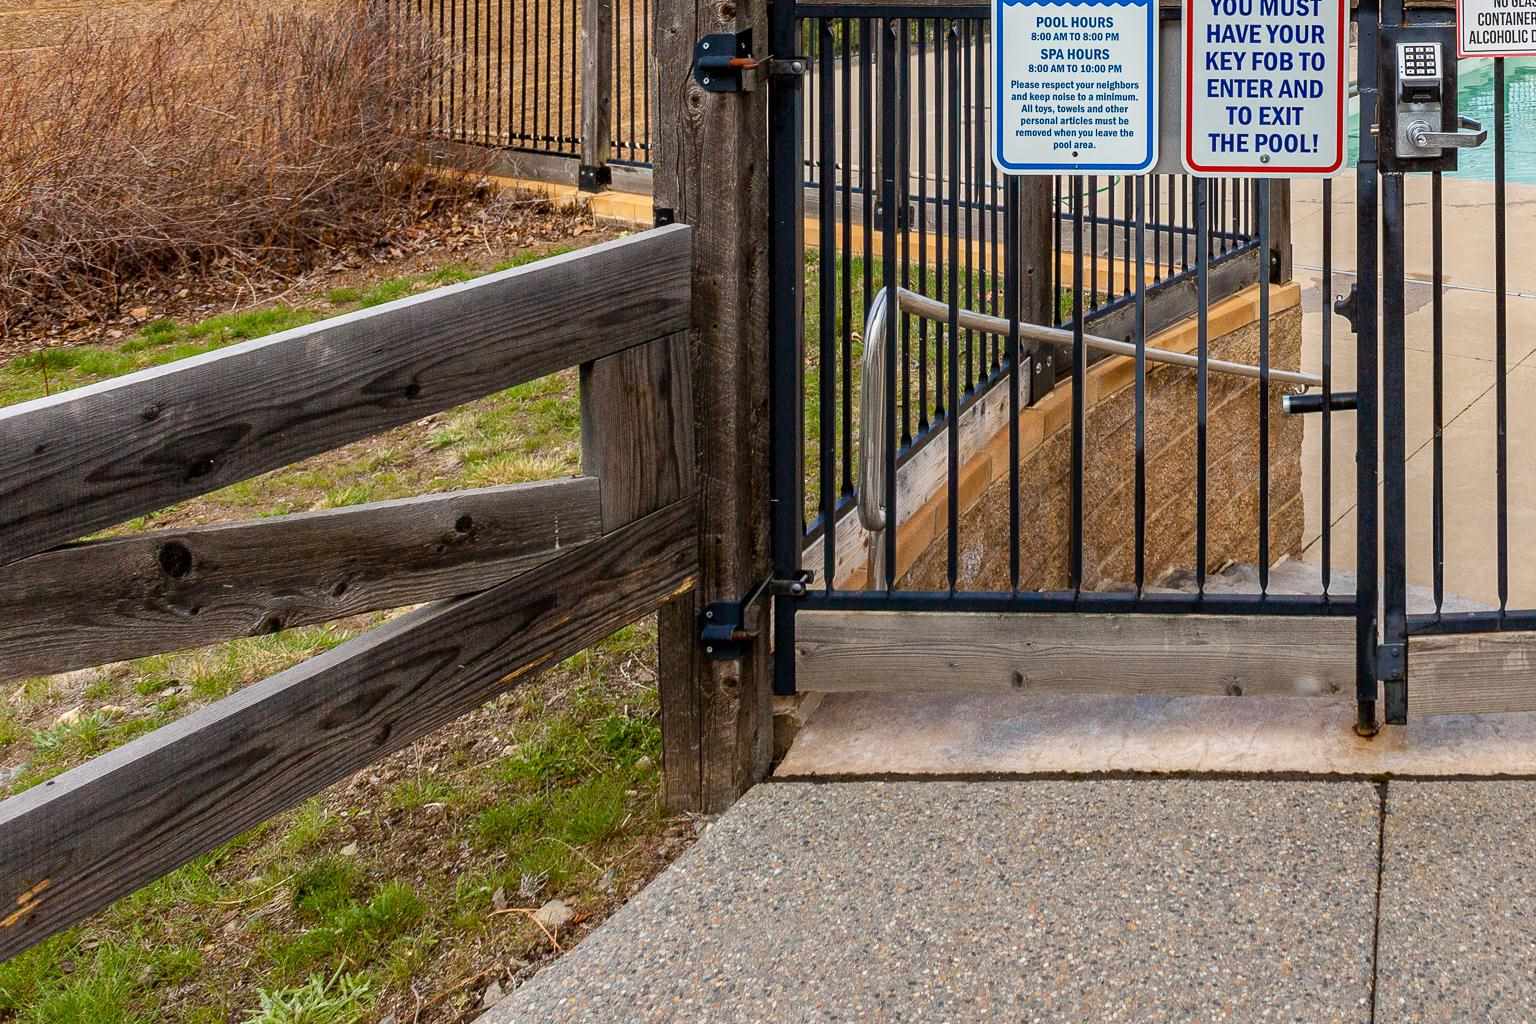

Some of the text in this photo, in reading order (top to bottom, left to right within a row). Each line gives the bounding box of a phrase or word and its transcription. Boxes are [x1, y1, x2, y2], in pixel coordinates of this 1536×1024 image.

[1036, 17, 1113, 28] POOL HOURS
[1207, 24, 1325, 44] HAVE YOUR
[1469, 30, 1528, 44] ALCOHOLIC
[1041, 48, 1109, 59] SPA HOURS
[1206, 52, 1325, 71] KEY FOB TO
[1028, 65, 1122, 73] 8:00 AM TO 10:00 PM
[1042, 81, 1074, 90] respect
[1096, 81, 1139, 90] neighbors
[1208, 79, 1323, 99] ENTER AND
[1029, 93, 1050, 102] keep
[1095, 93, 1138, 101] minimum.
[1022, 105, 1128, 114] All toys, towels and other
[1226, 106, 1304, 125] TO EXIT
[1021, 117, 1057, 126] personal
[1060, 117, 1093, 125] articles
[1118, 117, 1128, 125] be
[1016, 129, 1052, 137] removed
[1054, 129, 1076, 137] when
[1095, 129, 1117, 137] leave
[1120, 129, 1133, 137] the
[1054, 141, 1072, 150] pool
[1208, 134, 1318, 153] THE POOL!
